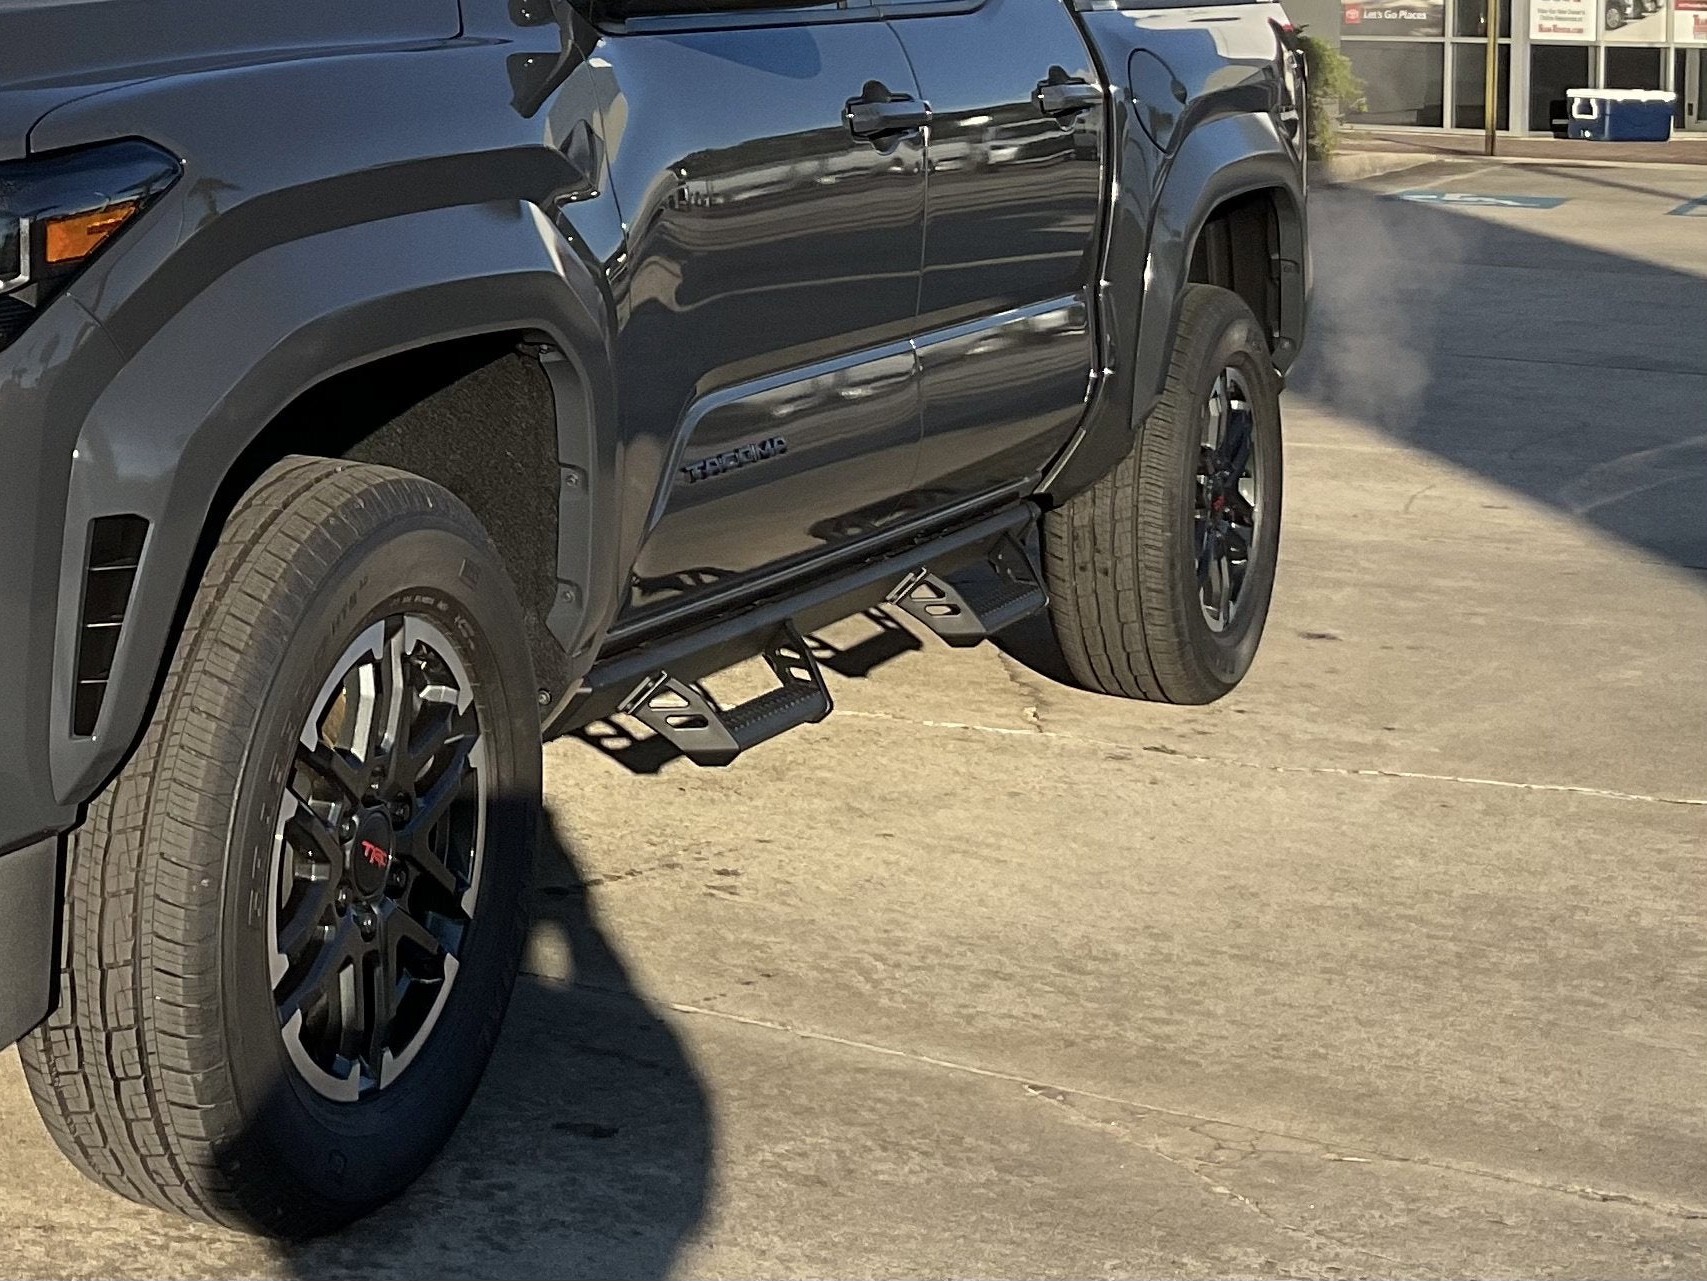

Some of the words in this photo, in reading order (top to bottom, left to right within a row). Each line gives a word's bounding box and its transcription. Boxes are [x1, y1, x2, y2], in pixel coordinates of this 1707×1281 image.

[1363, 9, 1383, 20] Let's
[1384, 9, 1397, 20] Go
[1398, 9, 1427, 20] Places
[680, 435, 787, 483] TACOMA
